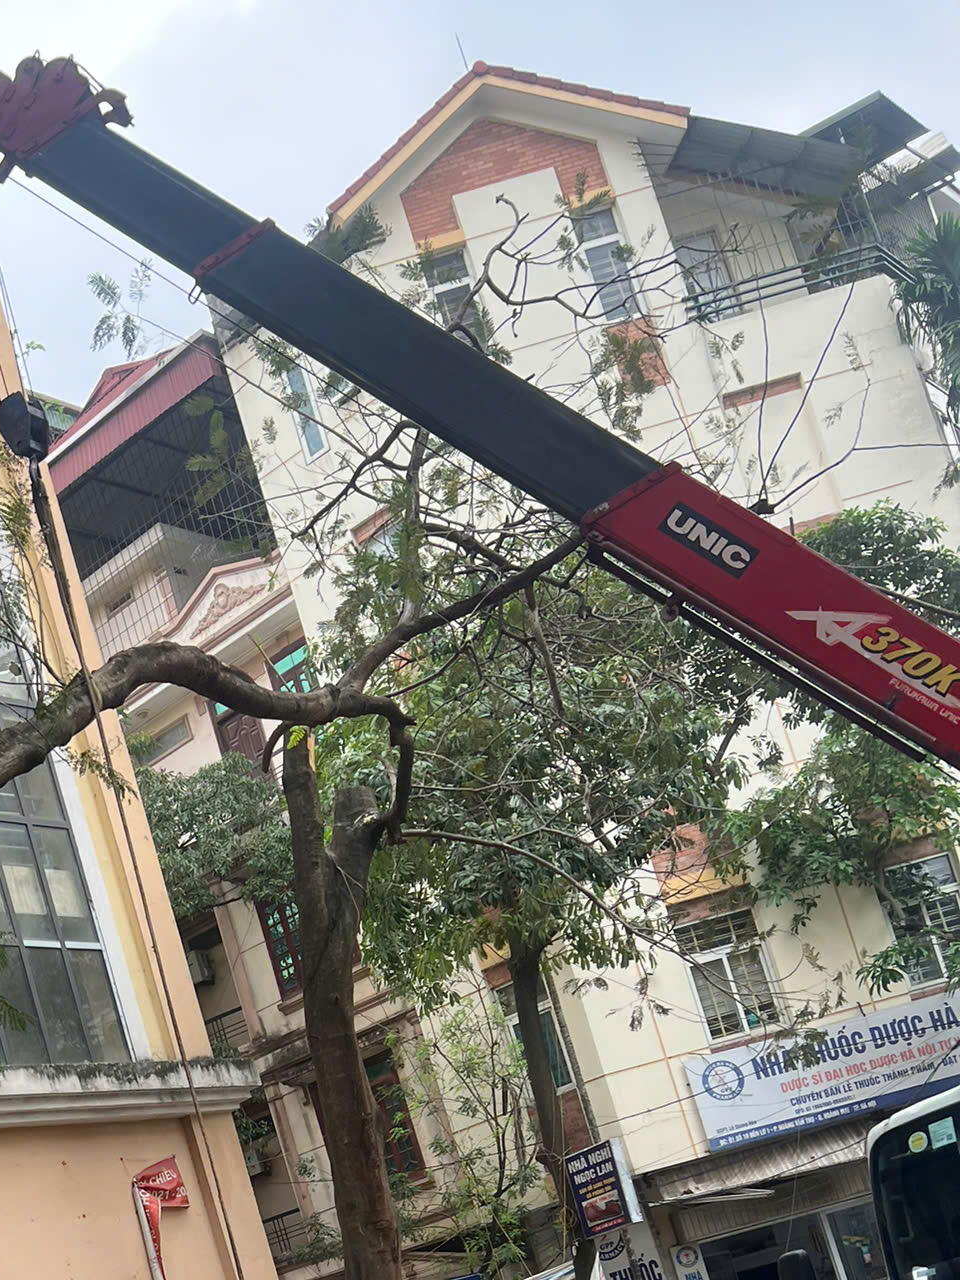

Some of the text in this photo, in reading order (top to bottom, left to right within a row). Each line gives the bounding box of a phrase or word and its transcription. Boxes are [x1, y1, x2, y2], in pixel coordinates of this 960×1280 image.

[667, 509, 750, 569] UNIC
[861, 627, 960, 697] 370K
[889, 677, 960, 725] FURUKAWA UNIC
[805, 1026, 866, 1068] HUỐC
[869, 1014, 927, 1049] DƯỢC
[780, 1075, 810, 1094] DƯỢC
[567, 1142, 612, 1174] NHÀ NGHỈ
[573, 1161, 613, 1185] NGỌC LAN
[149, 1190, 169, 1200] 021
